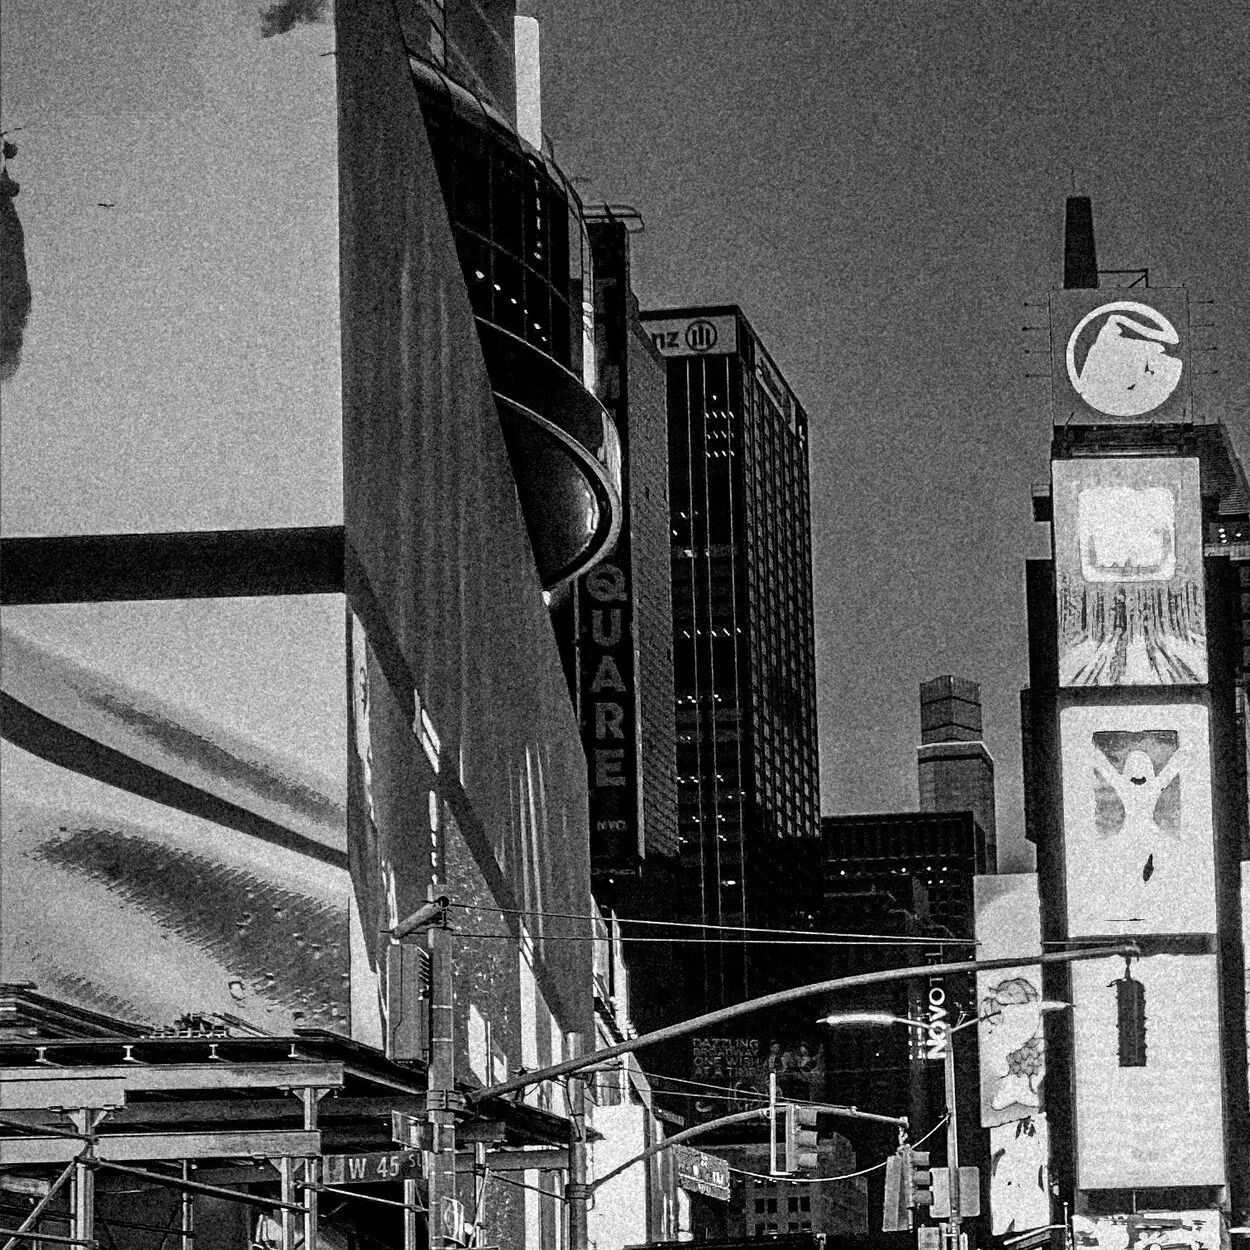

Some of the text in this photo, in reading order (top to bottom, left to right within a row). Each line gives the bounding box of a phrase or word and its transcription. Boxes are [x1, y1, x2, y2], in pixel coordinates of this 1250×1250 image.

[586, 563, 627, 787] QUARE
[348, 1158, 368, 1180] W
[376, 1155, 400, 1178] 45
